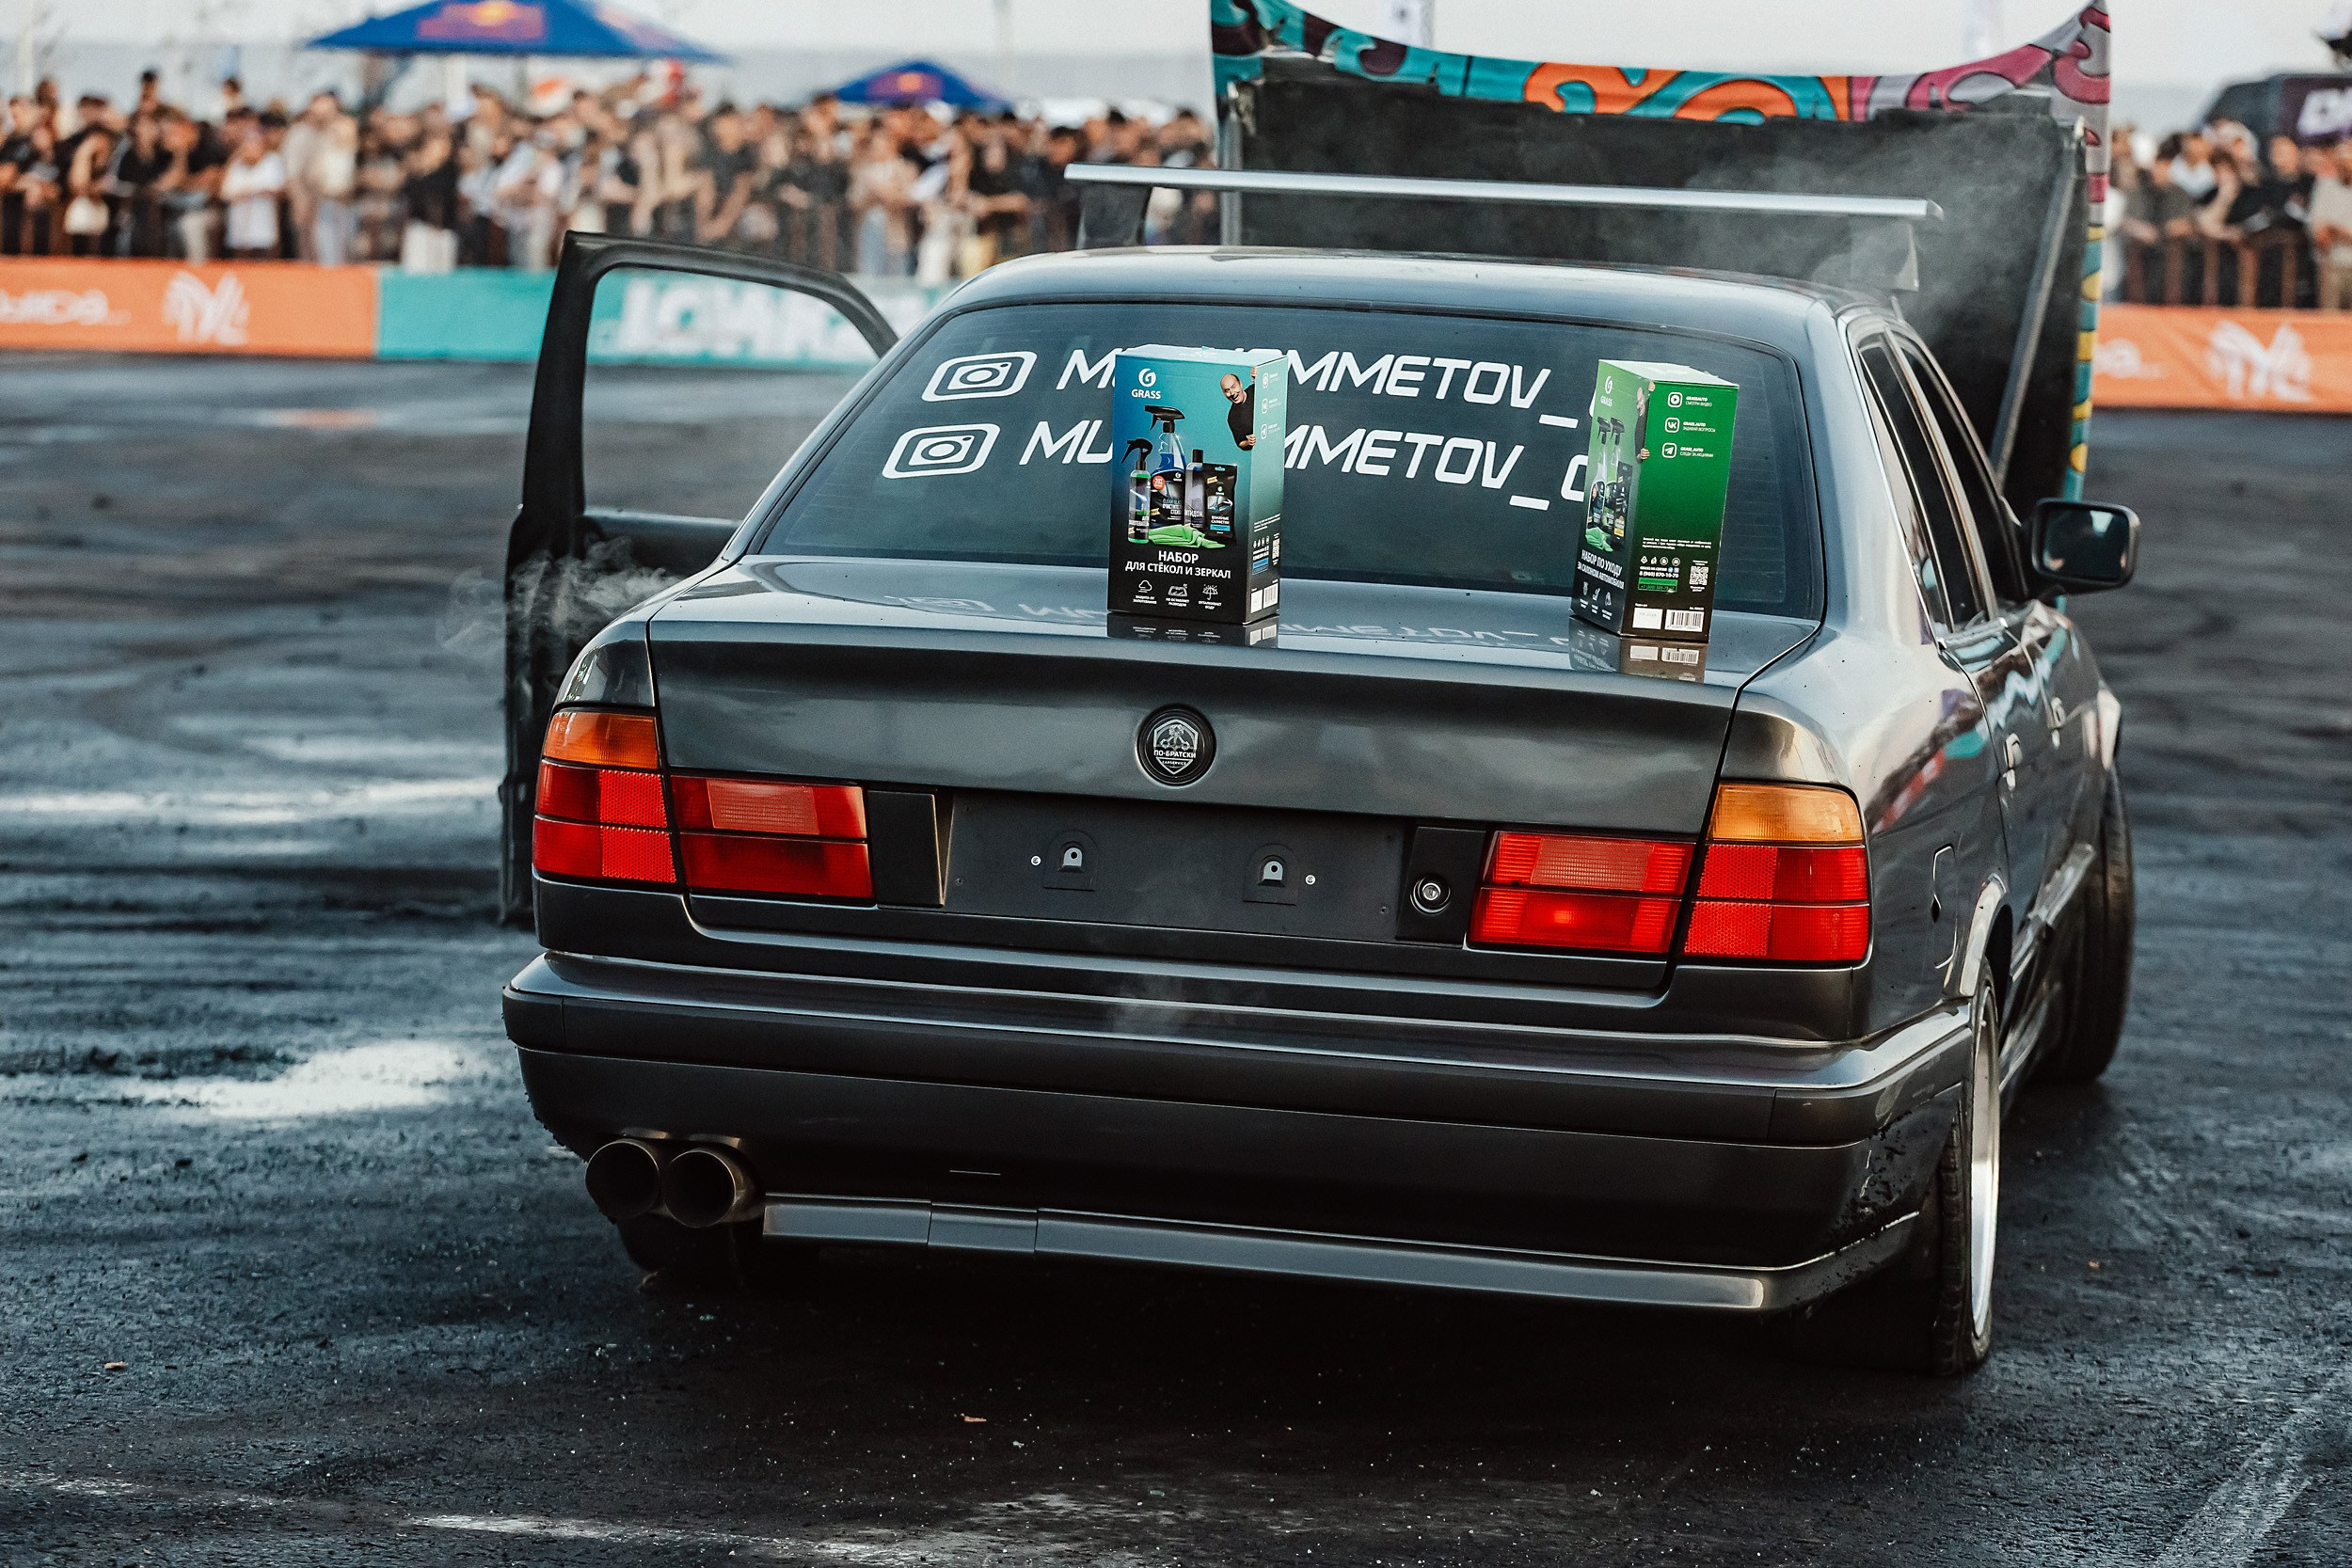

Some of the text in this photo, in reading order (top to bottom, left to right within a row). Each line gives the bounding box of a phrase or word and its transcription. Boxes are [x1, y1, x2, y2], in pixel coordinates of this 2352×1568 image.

[1131, 388, 1162, 400] GRASS
[1158, 550, 1200, 564] НАБОР
[1581, 548, 1623, 578] НАБОР ПО УХОДУ
[1124, 561, 1232, 579] ДЛЯ СТЁКОЛ И ЗЕРКАЛ
[1153, 749, 1197, 759] ПО-БРАТСКИ
